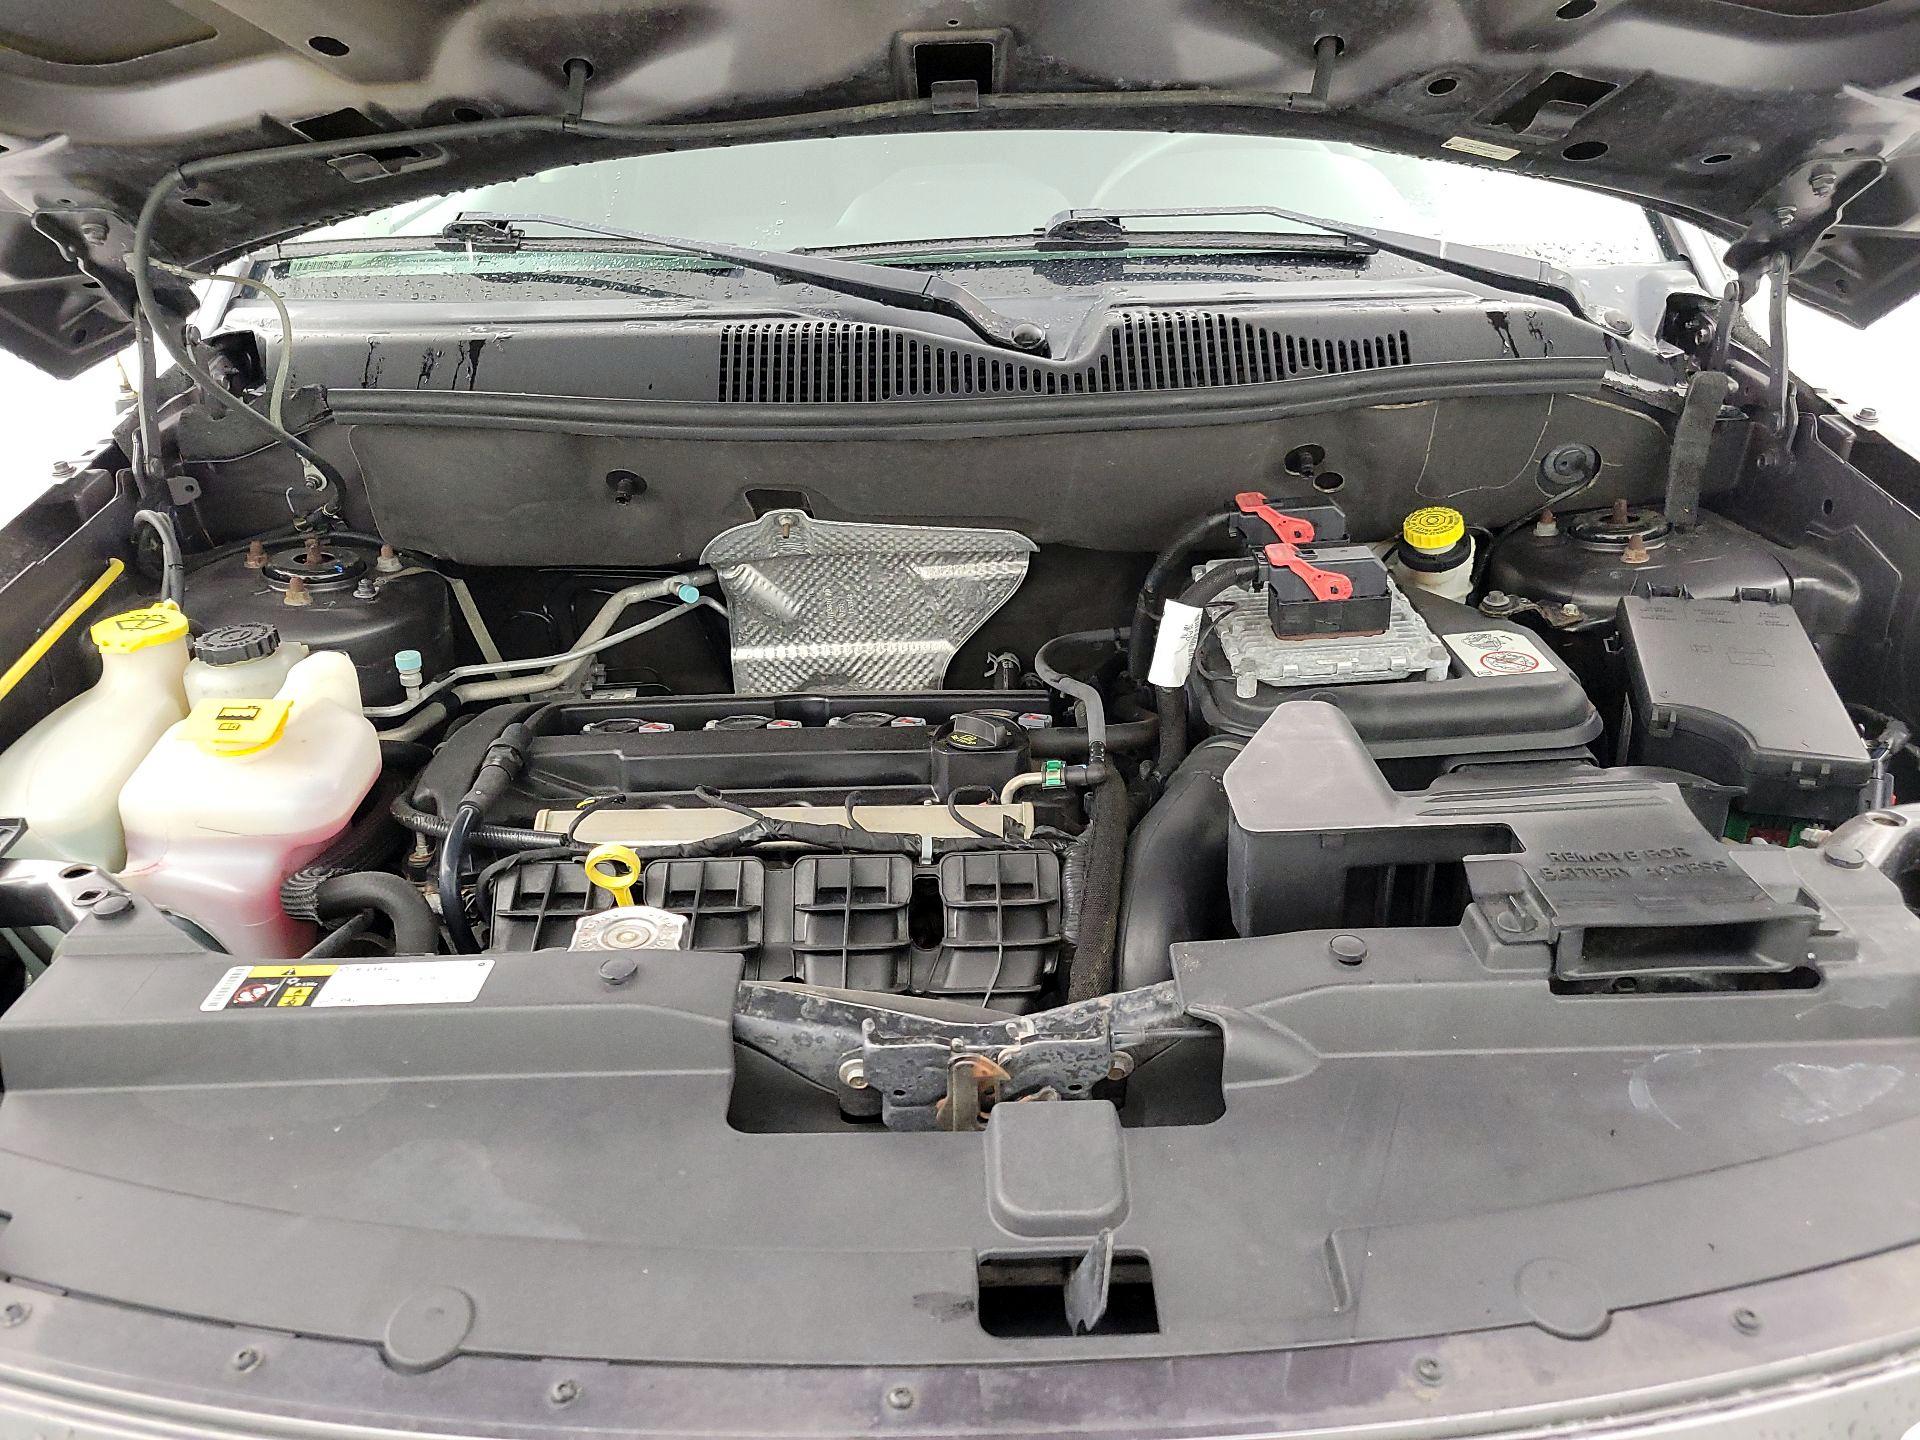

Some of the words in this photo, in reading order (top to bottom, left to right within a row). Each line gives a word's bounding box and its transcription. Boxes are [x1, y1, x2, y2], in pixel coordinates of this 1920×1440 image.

[1545, 850, 1641, 863] REMOVE
[1643, 847, 1692, 859] FOR
[1539, 866, 1632, 881] BATTERY
